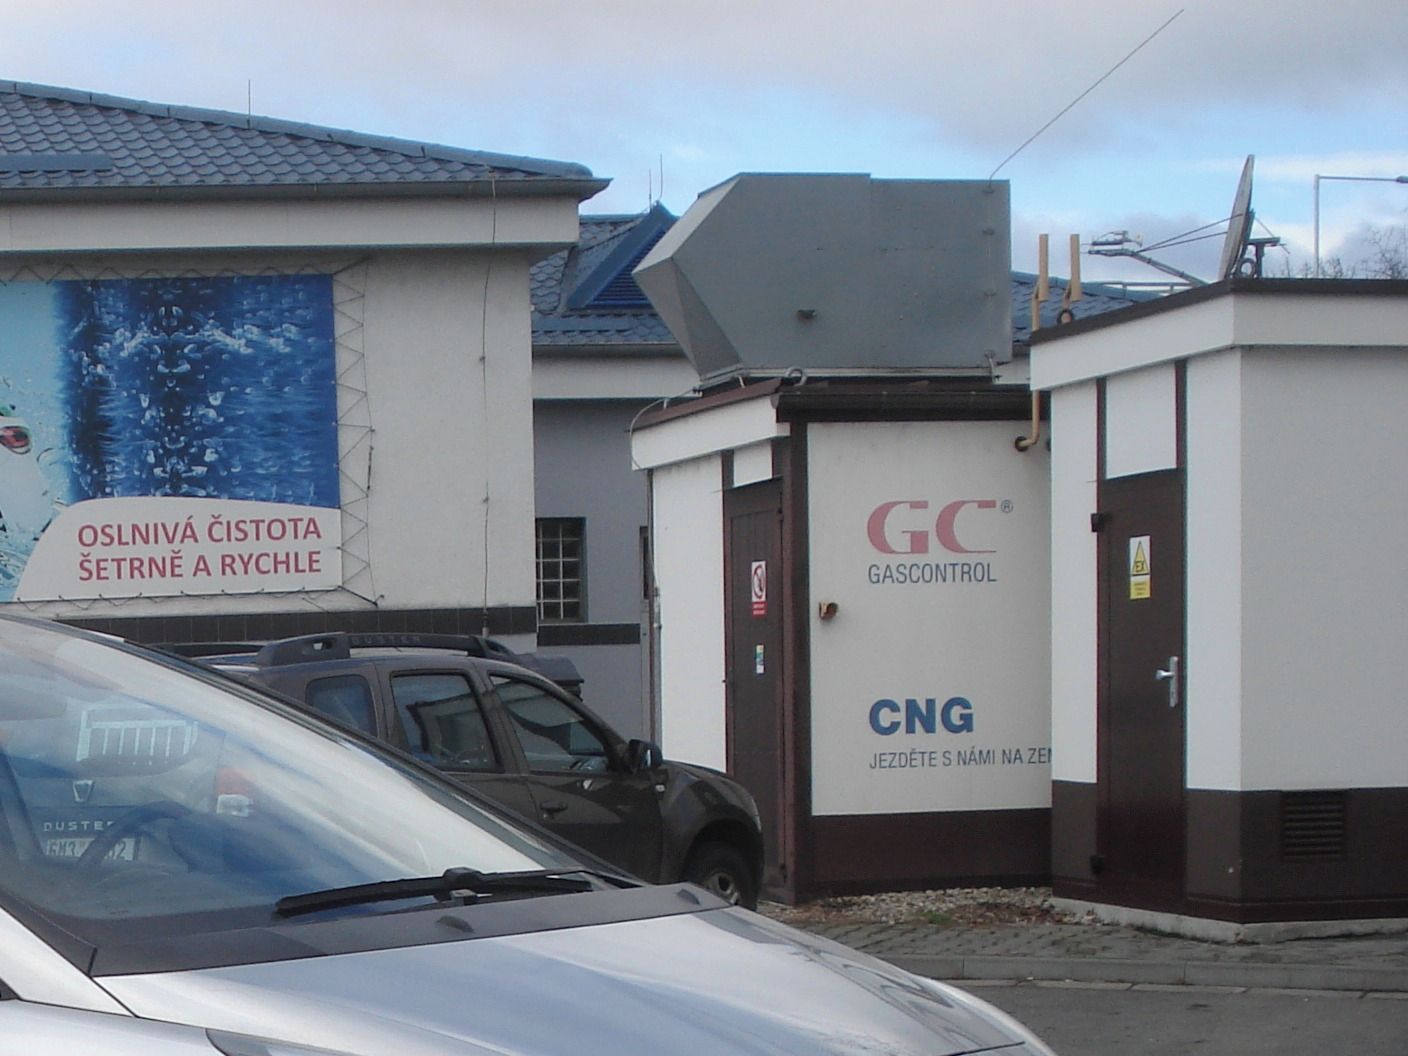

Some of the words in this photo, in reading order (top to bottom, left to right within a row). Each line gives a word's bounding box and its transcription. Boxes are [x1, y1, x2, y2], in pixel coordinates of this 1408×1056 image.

[77, 515, 199, 547] OSLNIVÁ
[207, 514, 322, 543] ČISTOTA
[79, 550, 184, 581] ŠETRNĚ
[192, 554, 212, 577] A
[221, 550, 322, 576] RYCHLE
[868, 562, 997, 584] GASCONTROL
[868, 697, 974, 736] CNG
[869, 748, 937, 769] JEZDĚTE
[942, 750, 952, 767] S
[957, 746, 995, 766] NÁMI
[1002, 748, 1023, 765] NA
